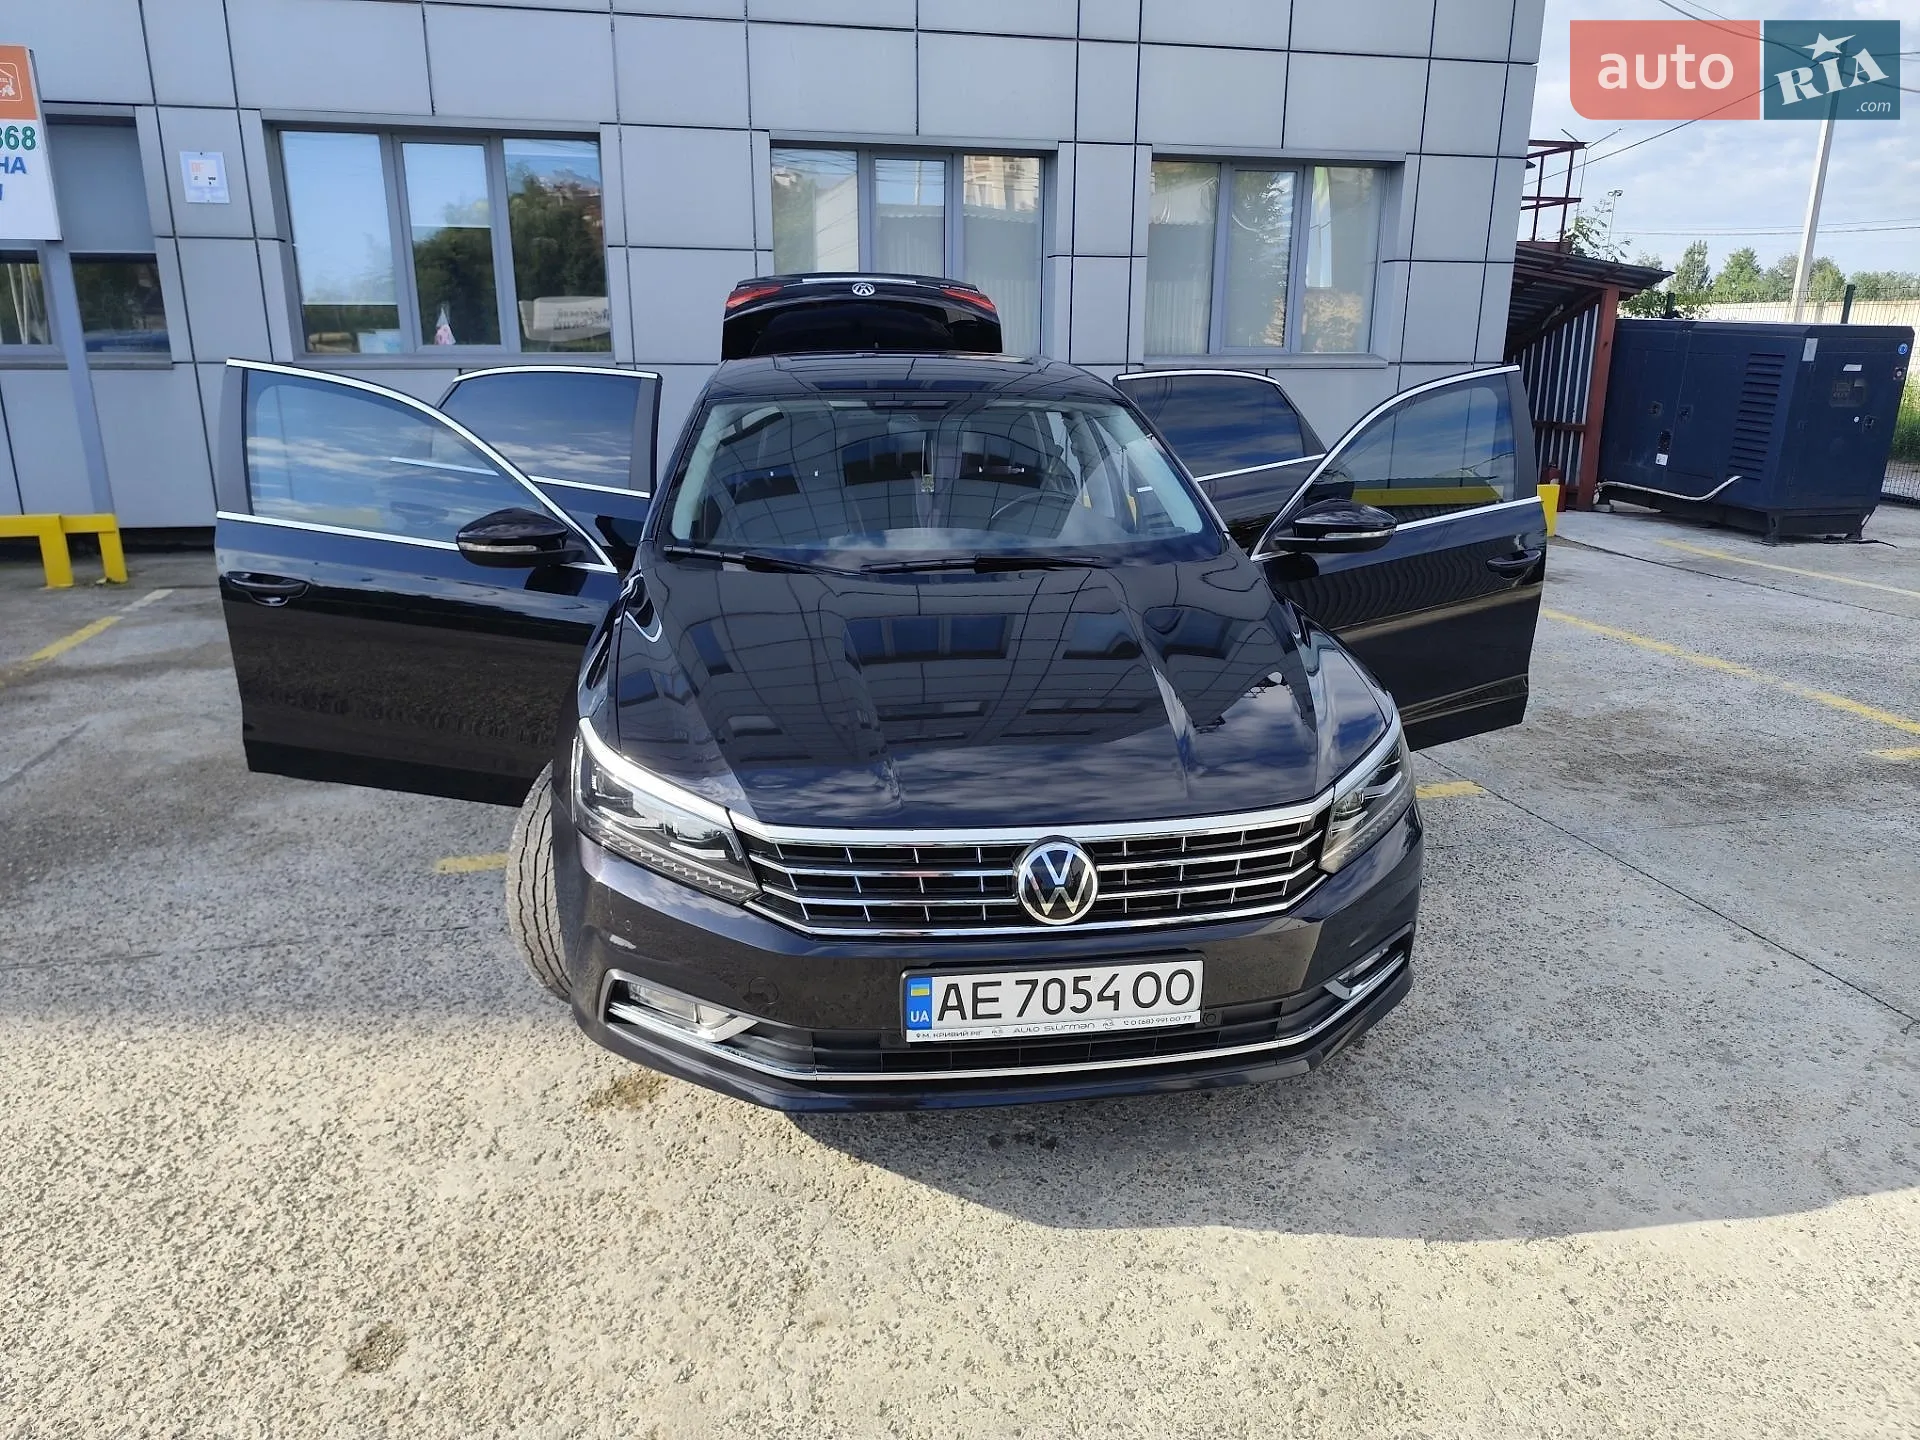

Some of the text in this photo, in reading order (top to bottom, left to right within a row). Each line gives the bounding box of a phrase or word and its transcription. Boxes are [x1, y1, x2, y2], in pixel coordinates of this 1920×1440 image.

[0, 125, 37, 151] 68
[937, 981, 1003, 1021] AE
[1015, 973, 1120, 1018] 7054
[911, 1010, 930, 1023] UA
